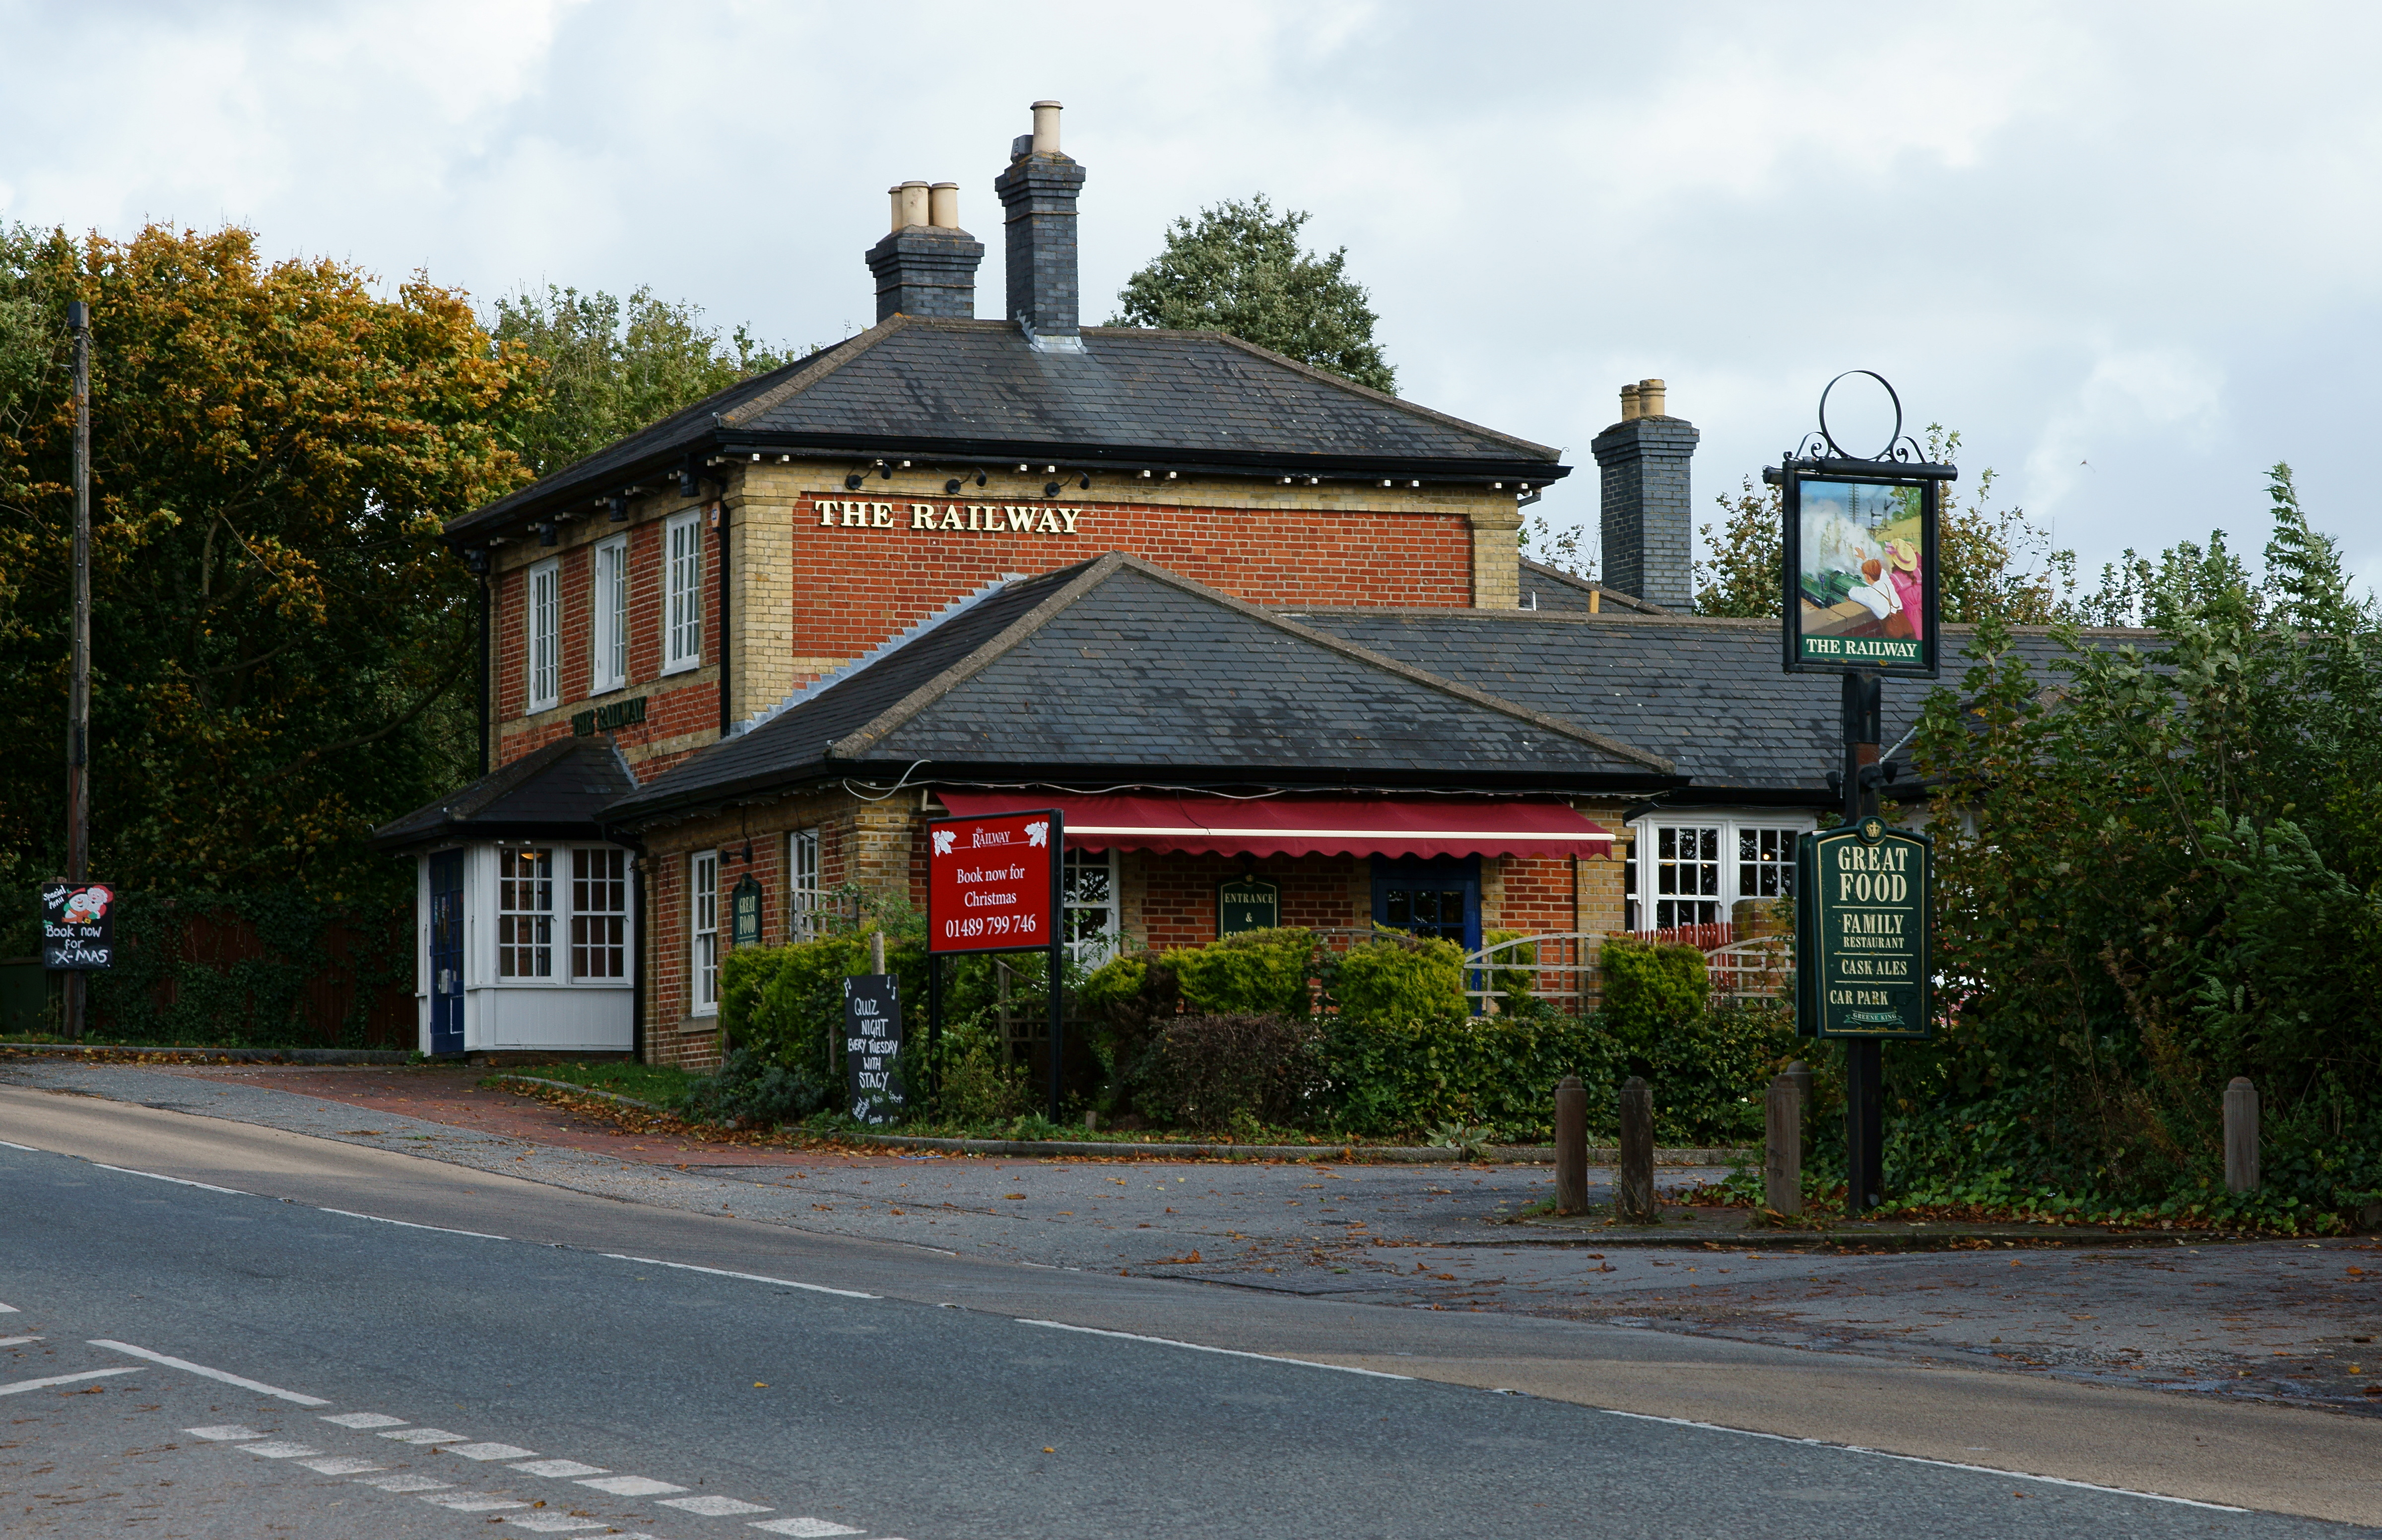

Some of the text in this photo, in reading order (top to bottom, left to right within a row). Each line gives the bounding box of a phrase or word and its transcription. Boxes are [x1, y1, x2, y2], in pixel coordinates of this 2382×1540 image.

[815, 500, 1082, 533] THE RAILWAY
[1806, 639, 1917, 657] THE RAILWAY
[572, 696, 647, 736] THE RAILWAY
[972, 832, 1010, 848] RAILWAY
[1838, 846, 1908, 871] GREAT
[957, 863, 1025, 884] Book now for
[43, 885, 66, 901] Special
[1840, 873, 1907, 902] FOOD
[739, 896, 755, 913] GREAT
[964, 891, 1016, 907] Christmas
[1225, 893, 1273, 903] ENTRANCE
[739, 915, 755, 935] FOOD
[946, 914, 1036, 938] 01489 799 746
[1246, 912, 1253, 922] &
[1843, 914, 1903, 934] FAMILY
[46, 925, 75, 937] Book
[65, 939, 84, 950] for
[1844, 937, 1904, 948] RESTAURANT
[1842, 959, 1907, 975] CASK ALES
[855, 997, 879, 1016] QUIZ
[1830, 990, 1888, 1005] CAR PARK
[861, 1019, 888, 1038] NIGHT
[848, 1038, 898, 1059] EVERY TUESDAY
[863, 1057, 881, 1071] WITH
[859, 1072, 889, 1091] STACY
